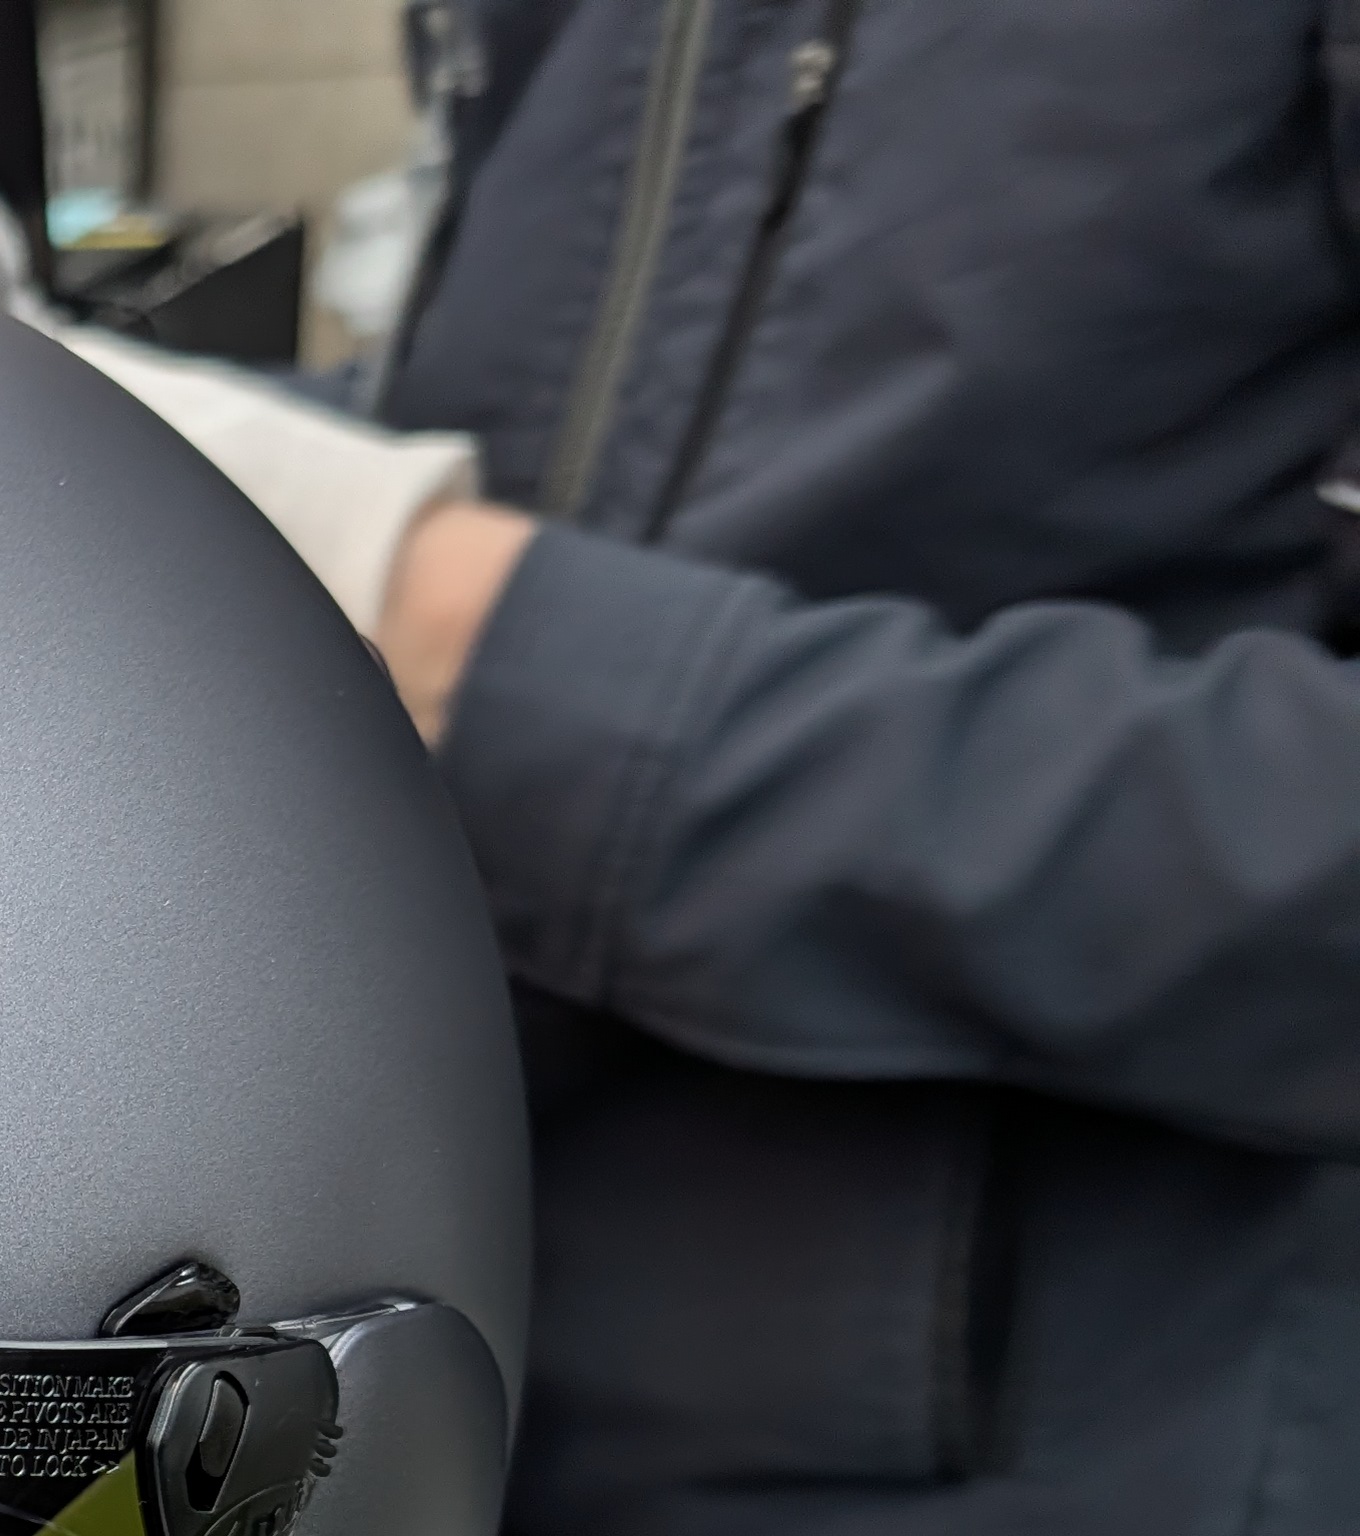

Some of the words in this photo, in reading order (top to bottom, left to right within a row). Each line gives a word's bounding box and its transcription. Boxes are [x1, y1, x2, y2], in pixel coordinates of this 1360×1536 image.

[70, 1375, 135, 1398] MAKE
[9, 1401, 86, 1424] PIVOTS
[87, 1402, 131, 1424] ARE
[34, 1428, 60, 1450] IN
[59, 1428, 128, 1454] JAPAN
[30, 1454, 90, 1477] LOCK
